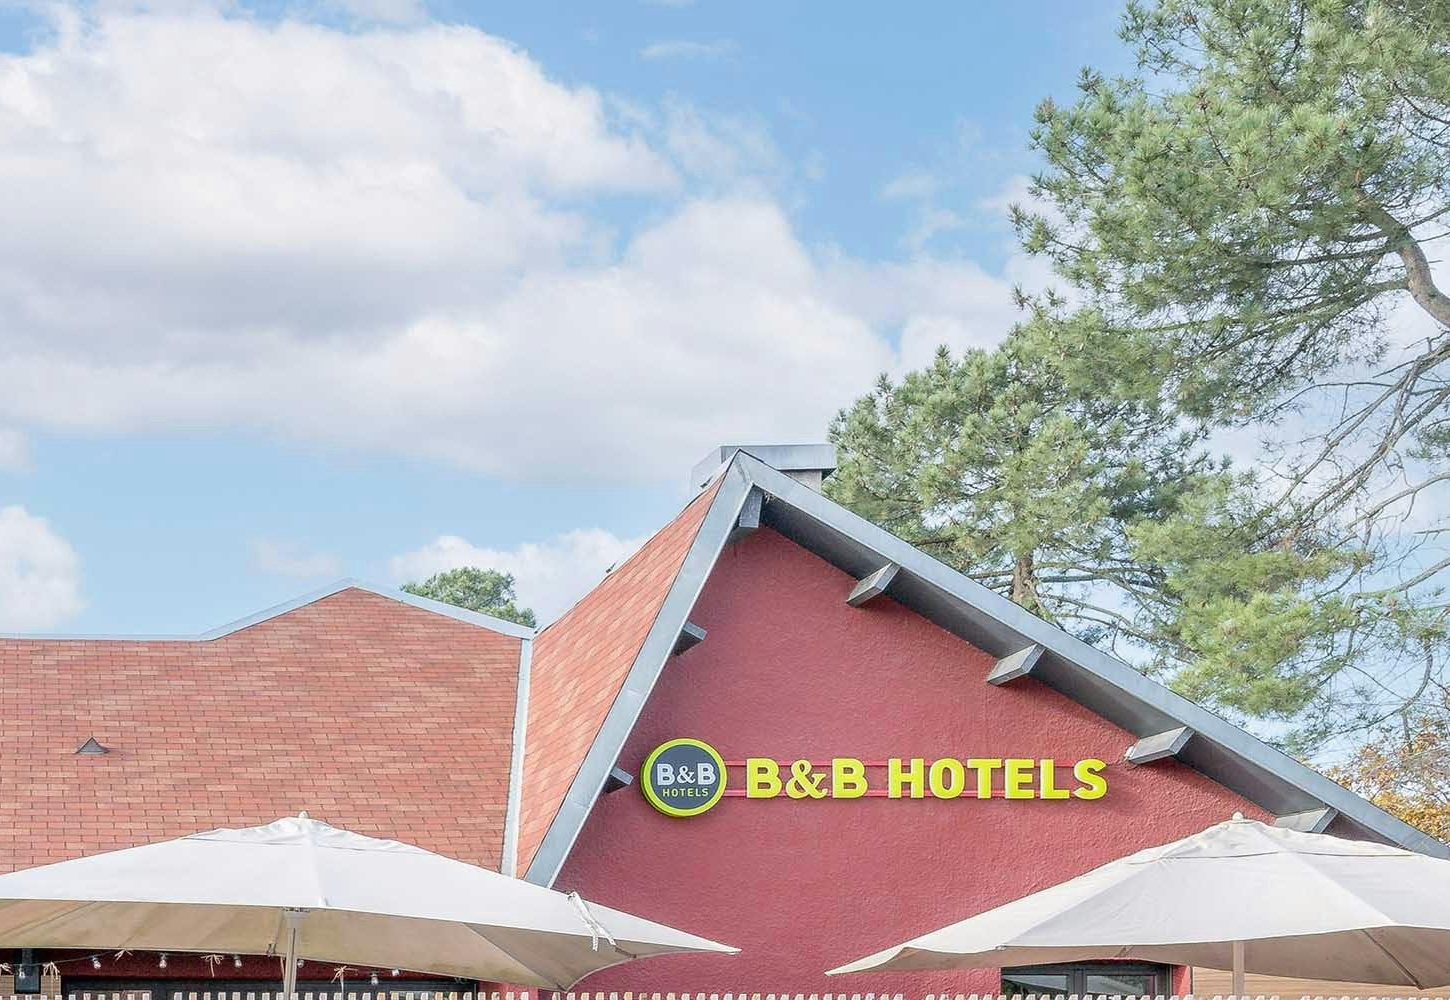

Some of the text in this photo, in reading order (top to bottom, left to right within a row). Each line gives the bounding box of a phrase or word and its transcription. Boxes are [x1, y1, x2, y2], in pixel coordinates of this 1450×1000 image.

[657, 763, 716, 785] B&B
[746, 758, 1108, 800] B&B HOTELS
[662, 788, 709, 797] HOTELS
